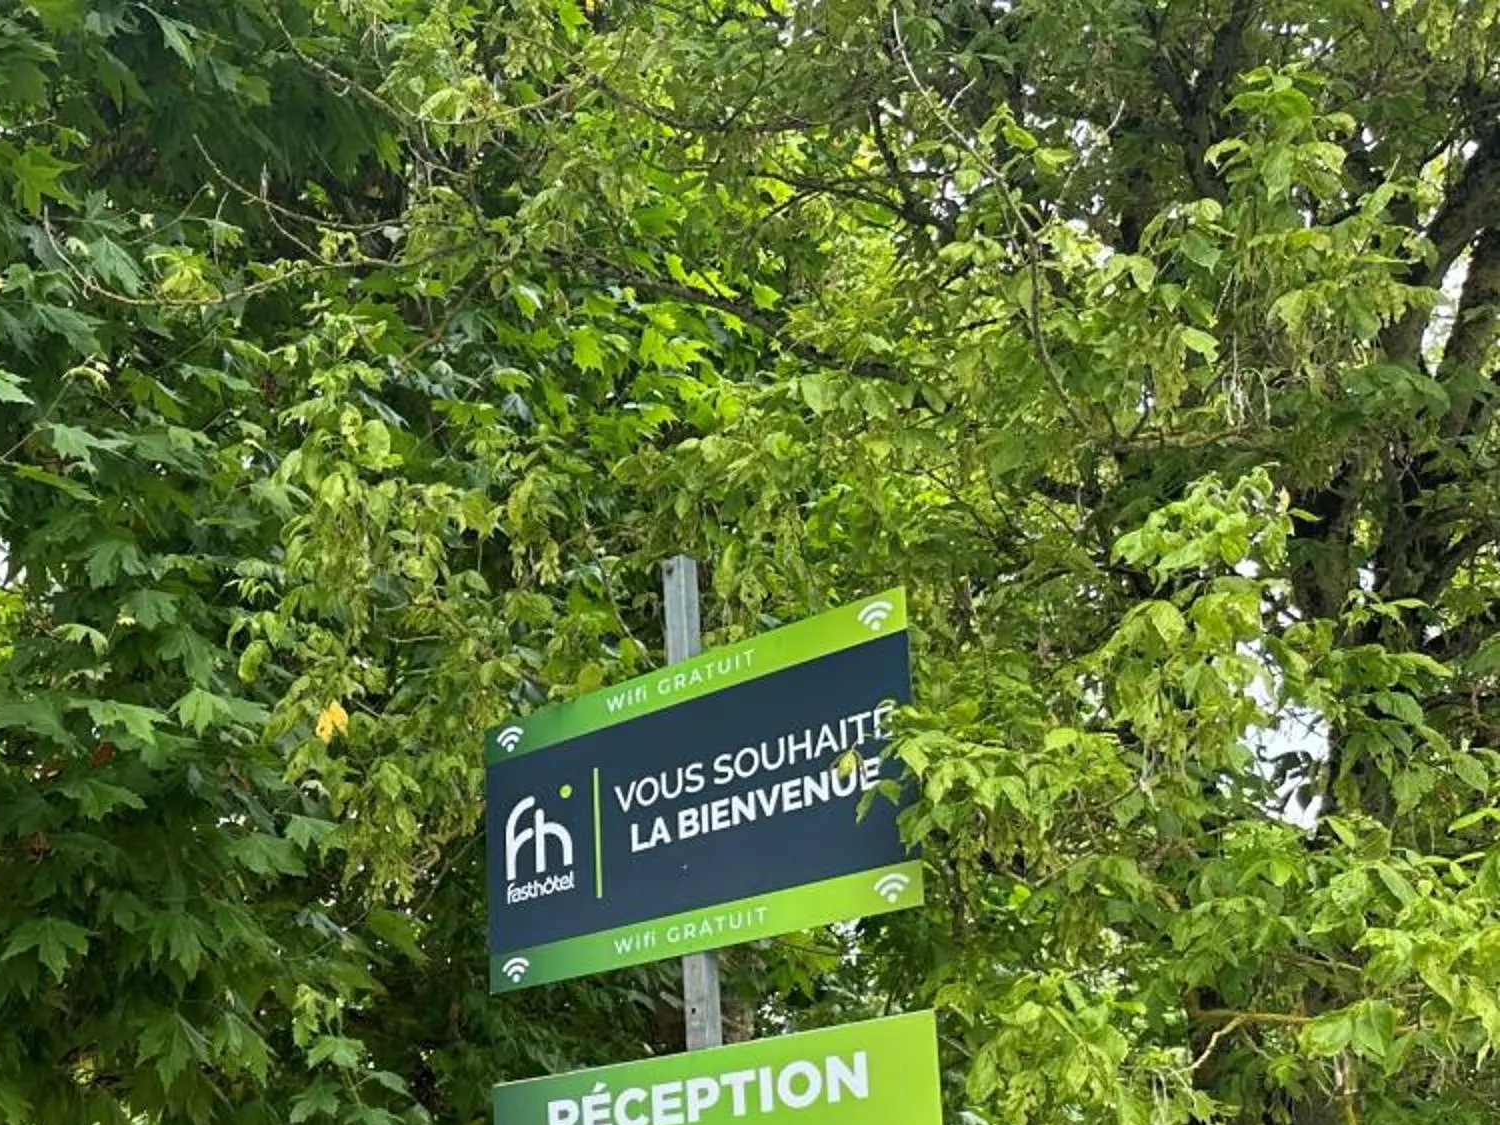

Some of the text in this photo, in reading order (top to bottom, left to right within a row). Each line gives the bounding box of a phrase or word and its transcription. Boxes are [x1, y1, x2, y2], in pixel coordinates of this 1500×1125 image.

[605, 648, 756, 713] Wifi GRATUIT
[613, 763, 704, 812] VOUS
[630, 757, 881, 852] LA BIENVENUE
[506, 871, 575, 905] fasthôtel
[613, 906, 770, 955] Wifi GRATUIT
